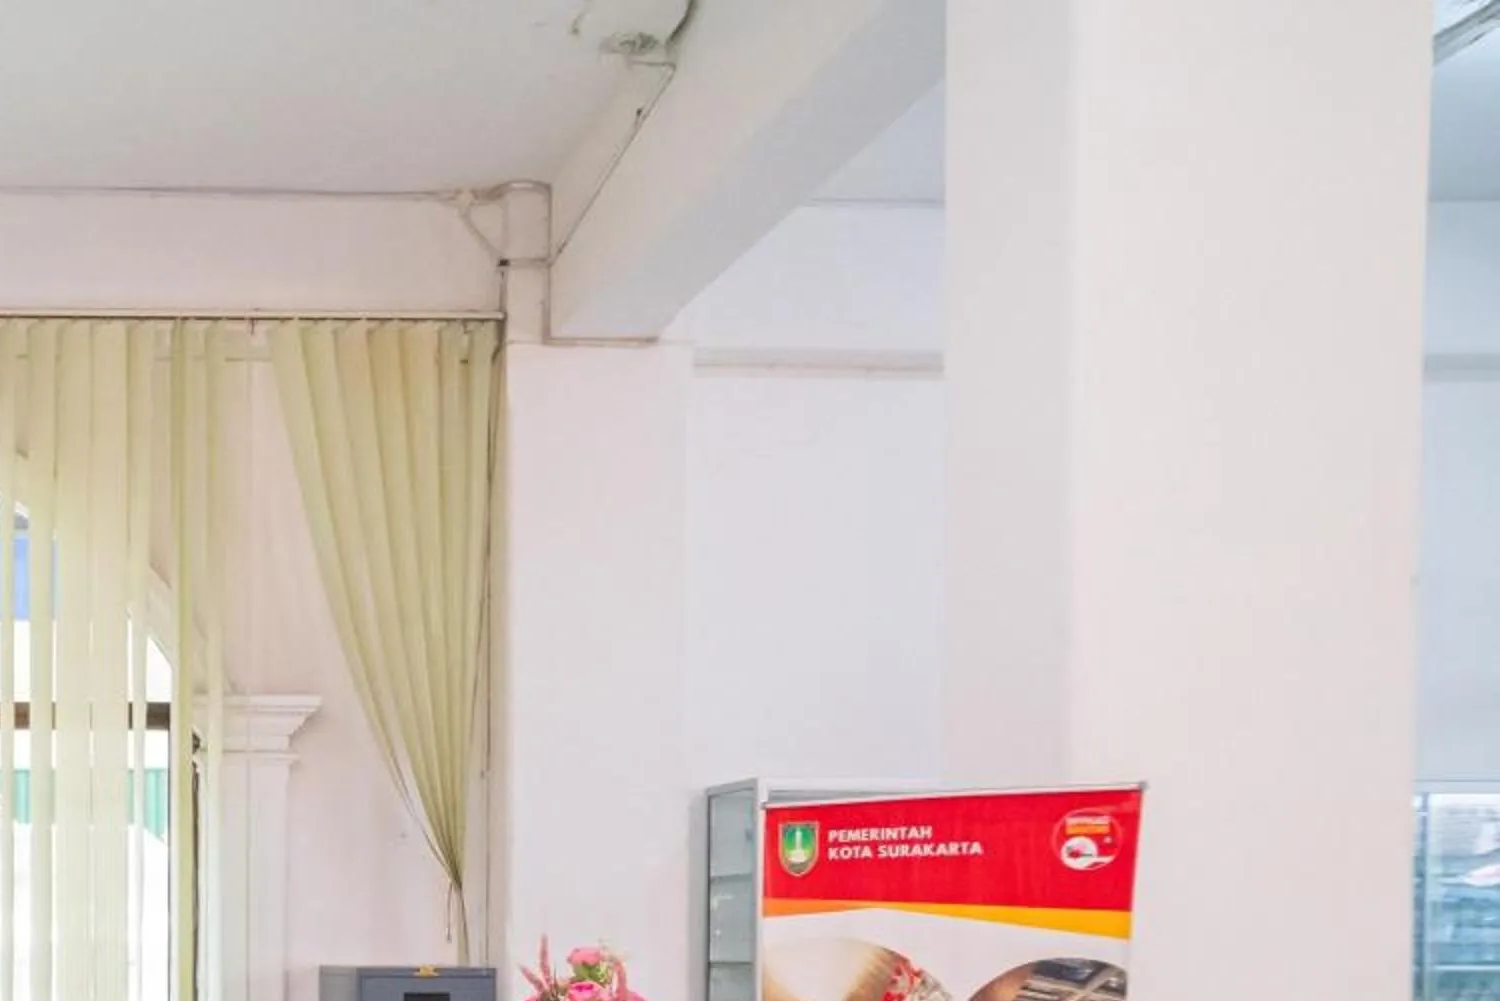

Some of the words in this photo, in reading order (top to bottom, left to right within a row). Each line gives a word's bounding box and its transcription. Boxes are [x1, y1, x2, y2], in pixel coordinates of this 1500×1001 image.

[828, 825, 933, 842] PEMERINTAH
[828, 845, 873, 861] KOTA
[877, 841, 984, 859] SURAKARTA
